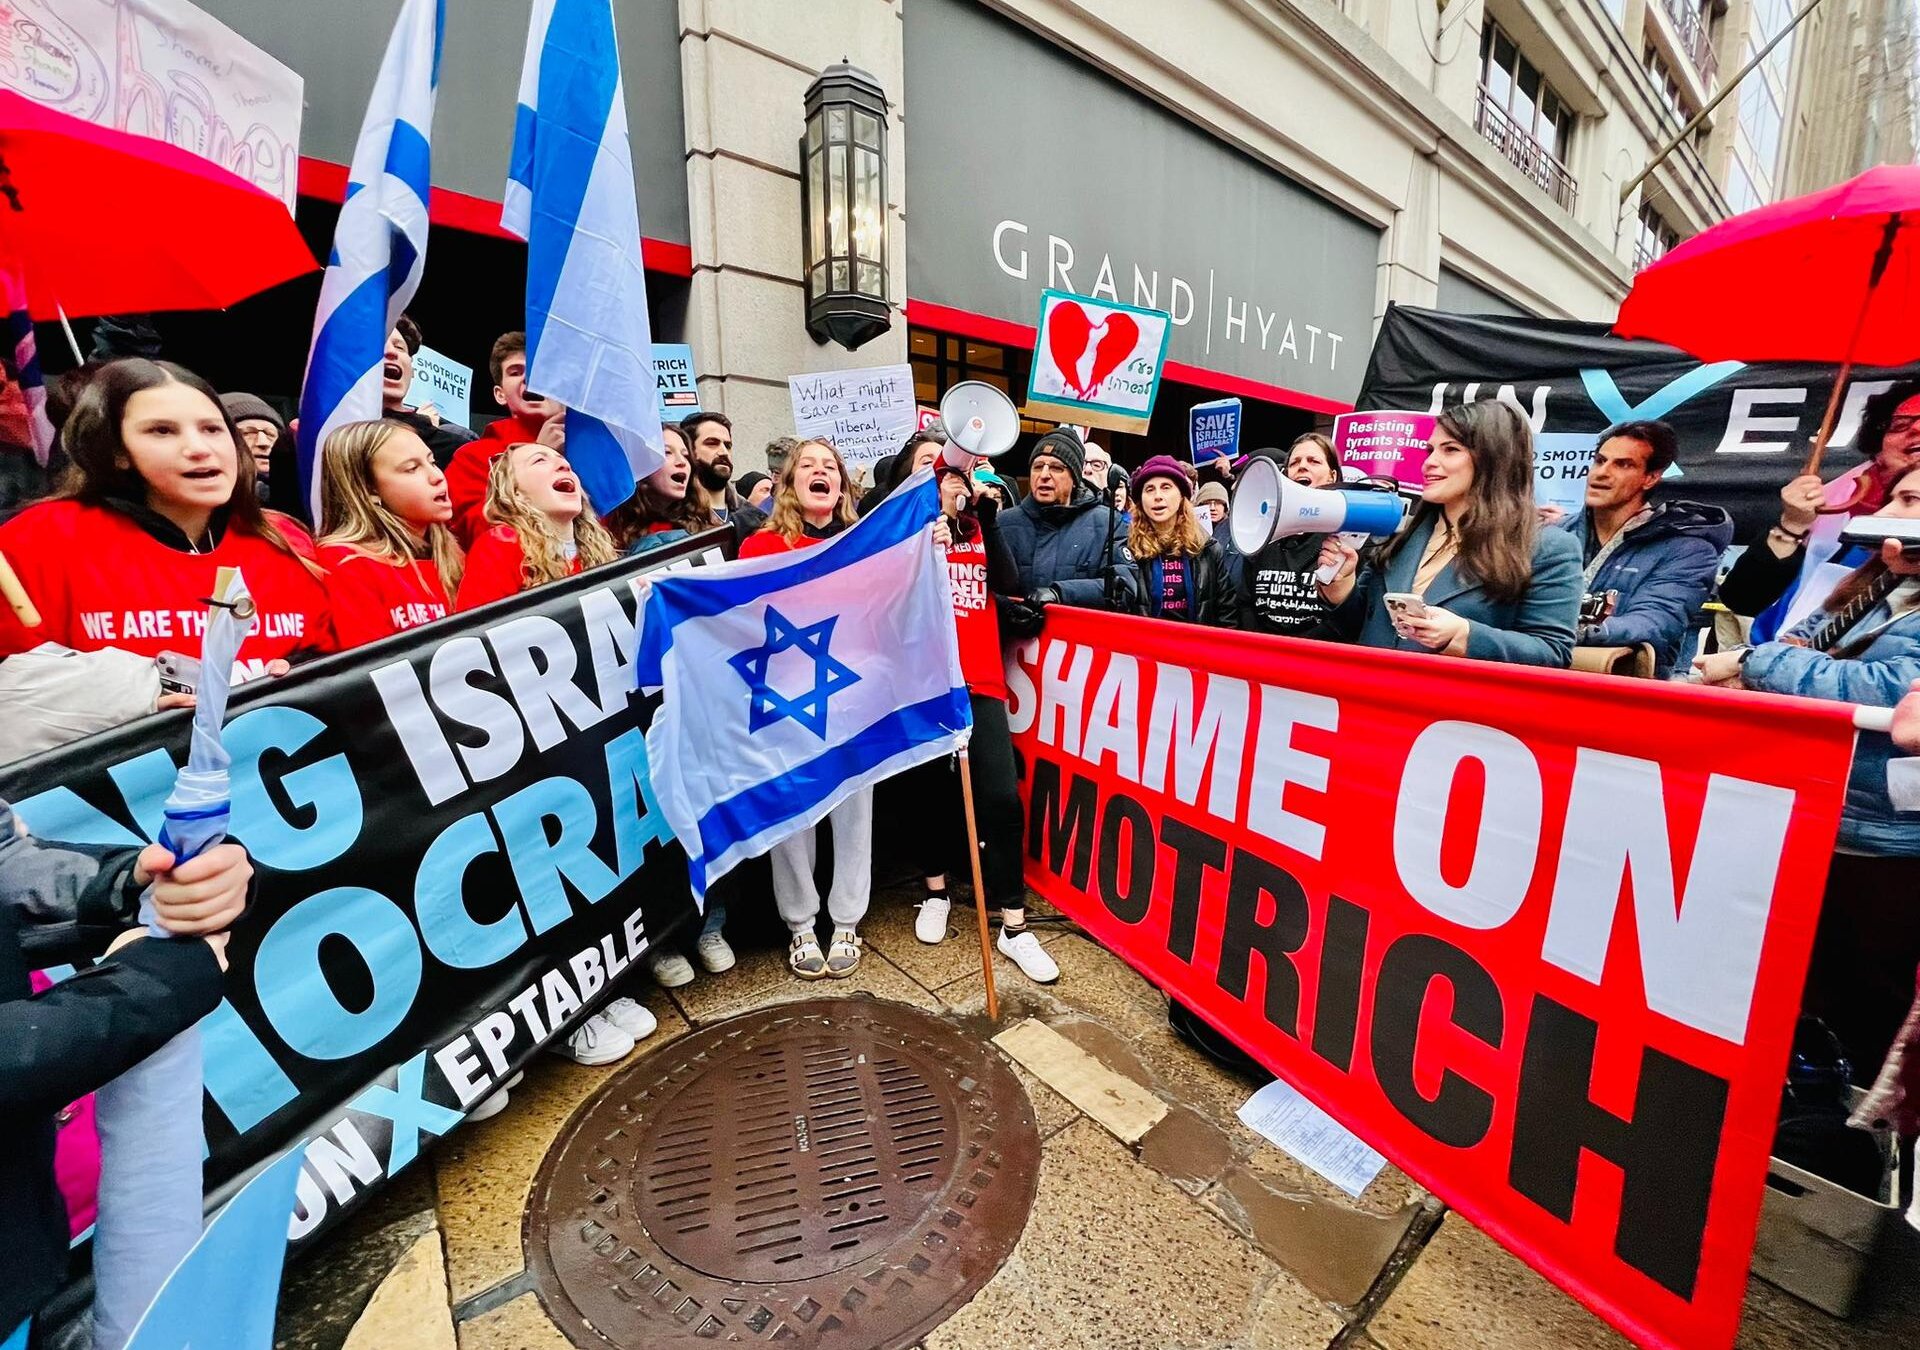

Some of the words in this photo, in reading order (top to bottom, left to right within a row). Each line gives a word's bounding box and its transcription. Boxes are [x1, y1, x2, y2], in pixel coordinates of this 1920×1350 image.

[993, 219, 1195, 327] GRAND
[1226, 296, 1344, 371] HYATT
[417, 358, 467, 386] SMOTRICH
[657, 374, 689, 389] ATE
[434, 375, 465, 400] HATE
[795, 378, 846, 401] What
[858, 377, 896, 402] might
[801, 403, 840, 420] save
[834, 417, 881, 434] liberal,
[1195, 413, 1236, 431] SAVE
[1348, 420, 1414, 439] Resisting
[1346, 436, 1393, 450] tyrants
[1396, 437, 1428, 449] sinc
[1343, 449, 1405, 462] Pharaoh.
[1561, 465, 1589, 479] HA
[948, 562, 987, 581] ING
[951, 580, 987, 599] AELI
[953, 594, 987, 610] CRACY
[81, 612, 115, 639] WE
[123, 611, 171, 638] ARE
[264, 613, 304, 638] LINE
[1004, 636, 1339, 862] SHAME
[1393, 718, 1797, 1046] ON
[1013, 745, 1731, 1303] MOTRICH
